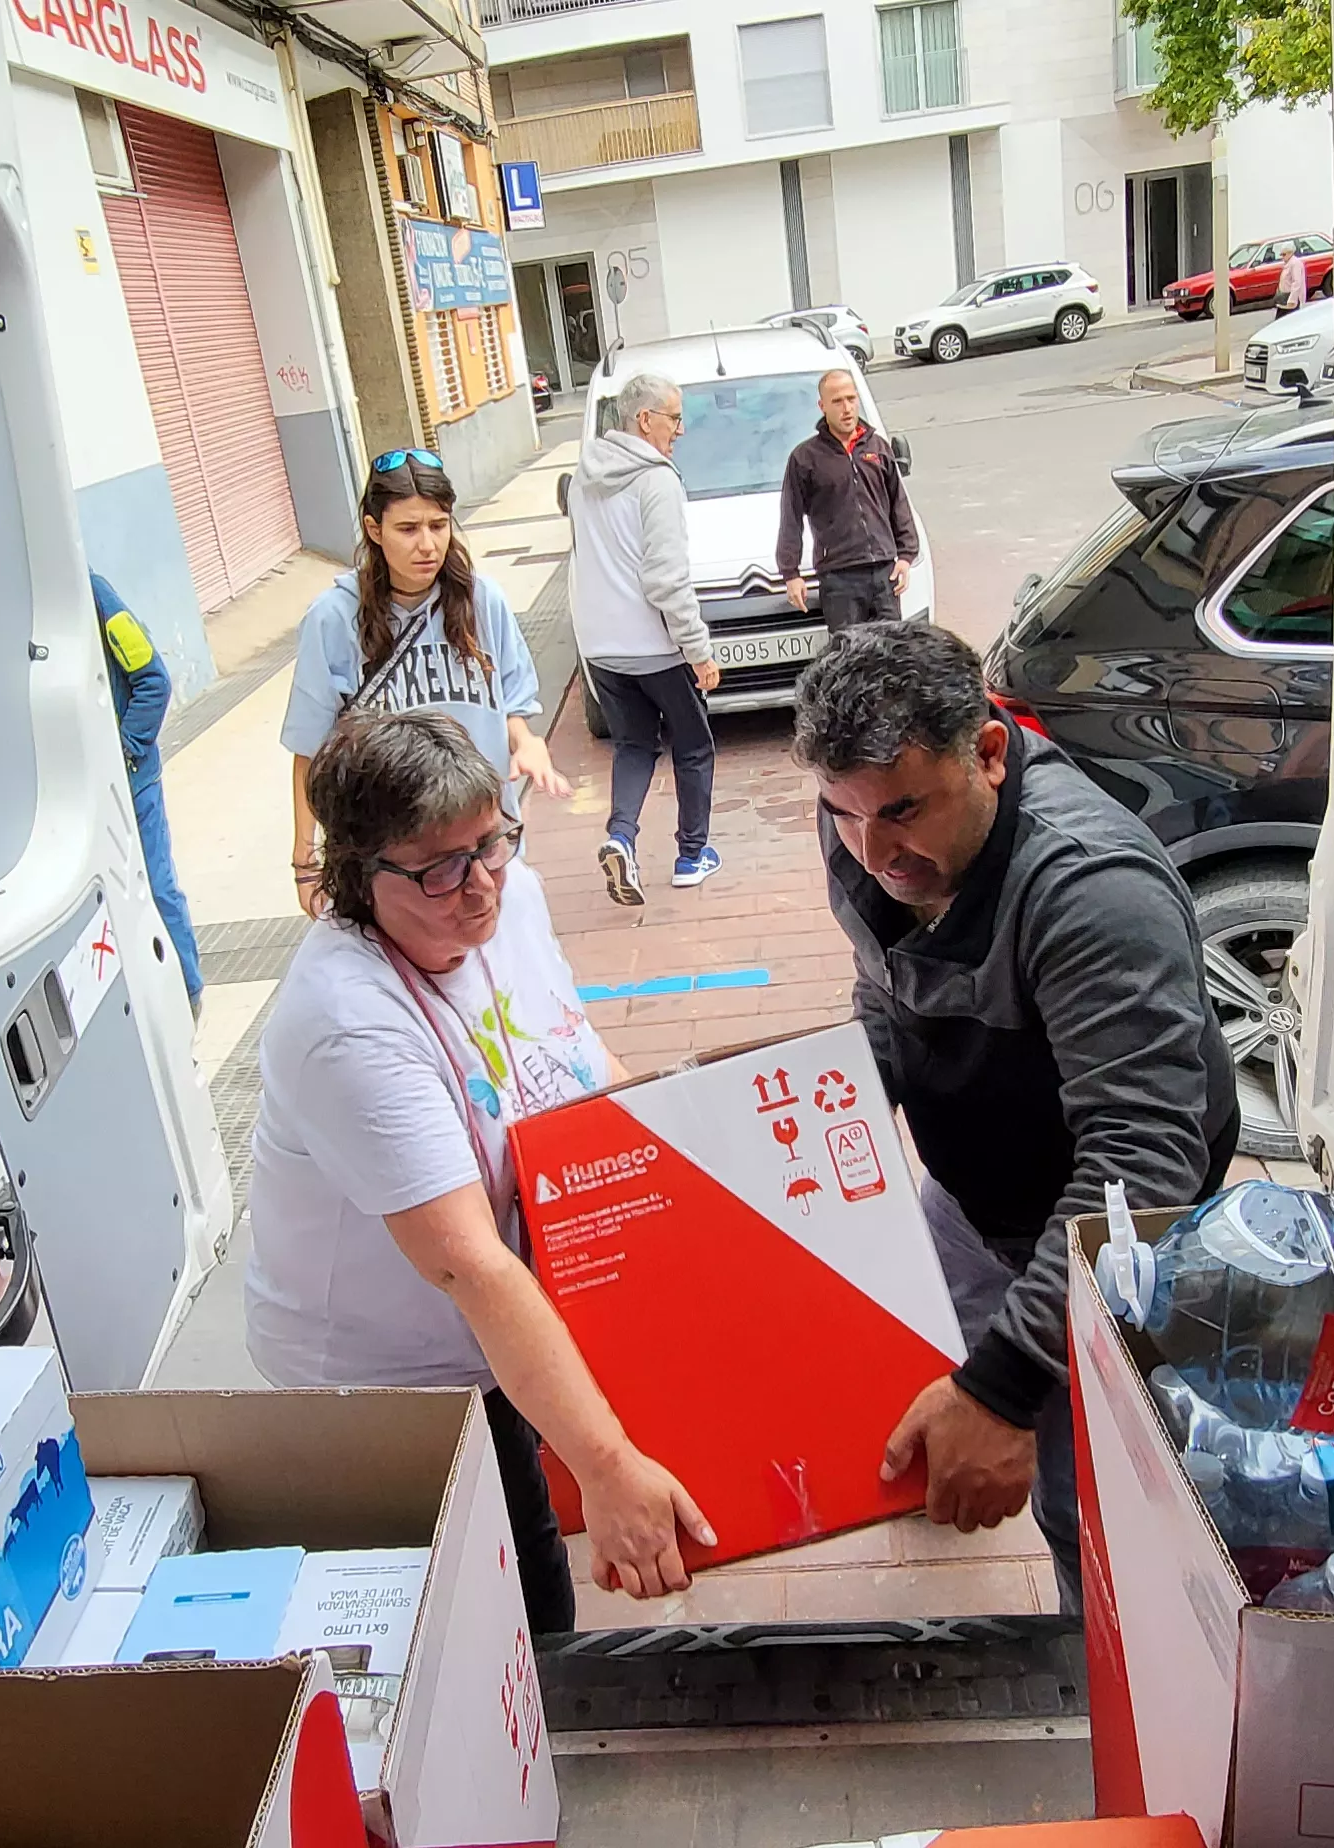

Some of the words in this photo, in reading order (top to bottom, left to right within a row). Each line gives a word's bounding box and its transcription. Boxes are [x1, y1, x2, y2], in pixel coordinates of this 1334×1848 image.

[16, 0, 207, 94] CARGLASS
[511, 168, 533, 207] L
[1074, 180, 1115, 216] 06
[720, 640, 769, 663] 9095
[777, 635, 815, 659] KDY
[562, 1144, 659, 1187] Humeco
[330, 1589, 358, 1600] VACA
[361, 1588, 377, 1599] DE
[381, 1587, 403, 1598] UHT
[317, 1597, 411, 1611] SEMIDESNATADA
[342, 1608, 379, 1620] LECHE
[323, 1624, 362, 1637] LITRO
[365, 1623, 389, 1636] 6x1
[334, 1677, 389, 1698] HACEN
